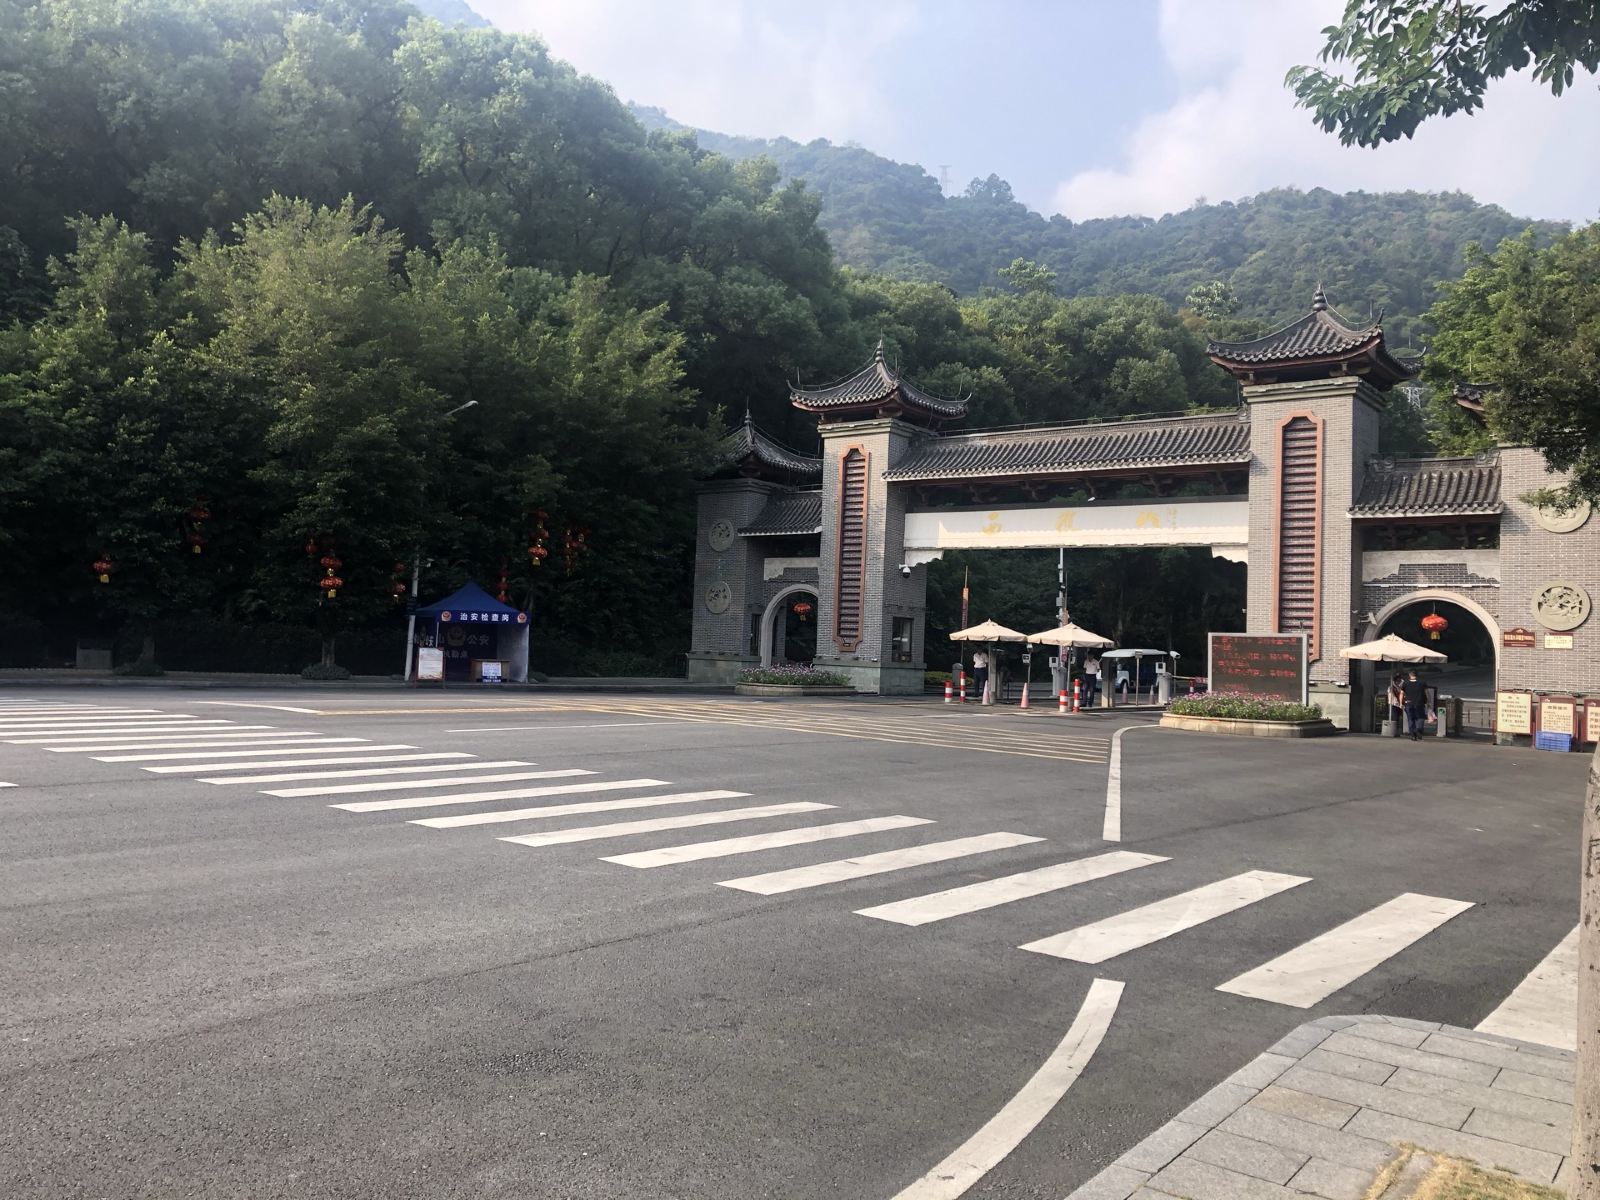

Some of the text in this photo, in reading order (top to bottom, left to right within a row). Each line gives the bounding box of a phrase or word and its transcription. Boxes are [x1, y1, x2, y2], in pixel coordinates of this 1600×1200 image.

[460, 612, 510, 622] 治安检查岗
[467, 633, 489, 646] 公安
